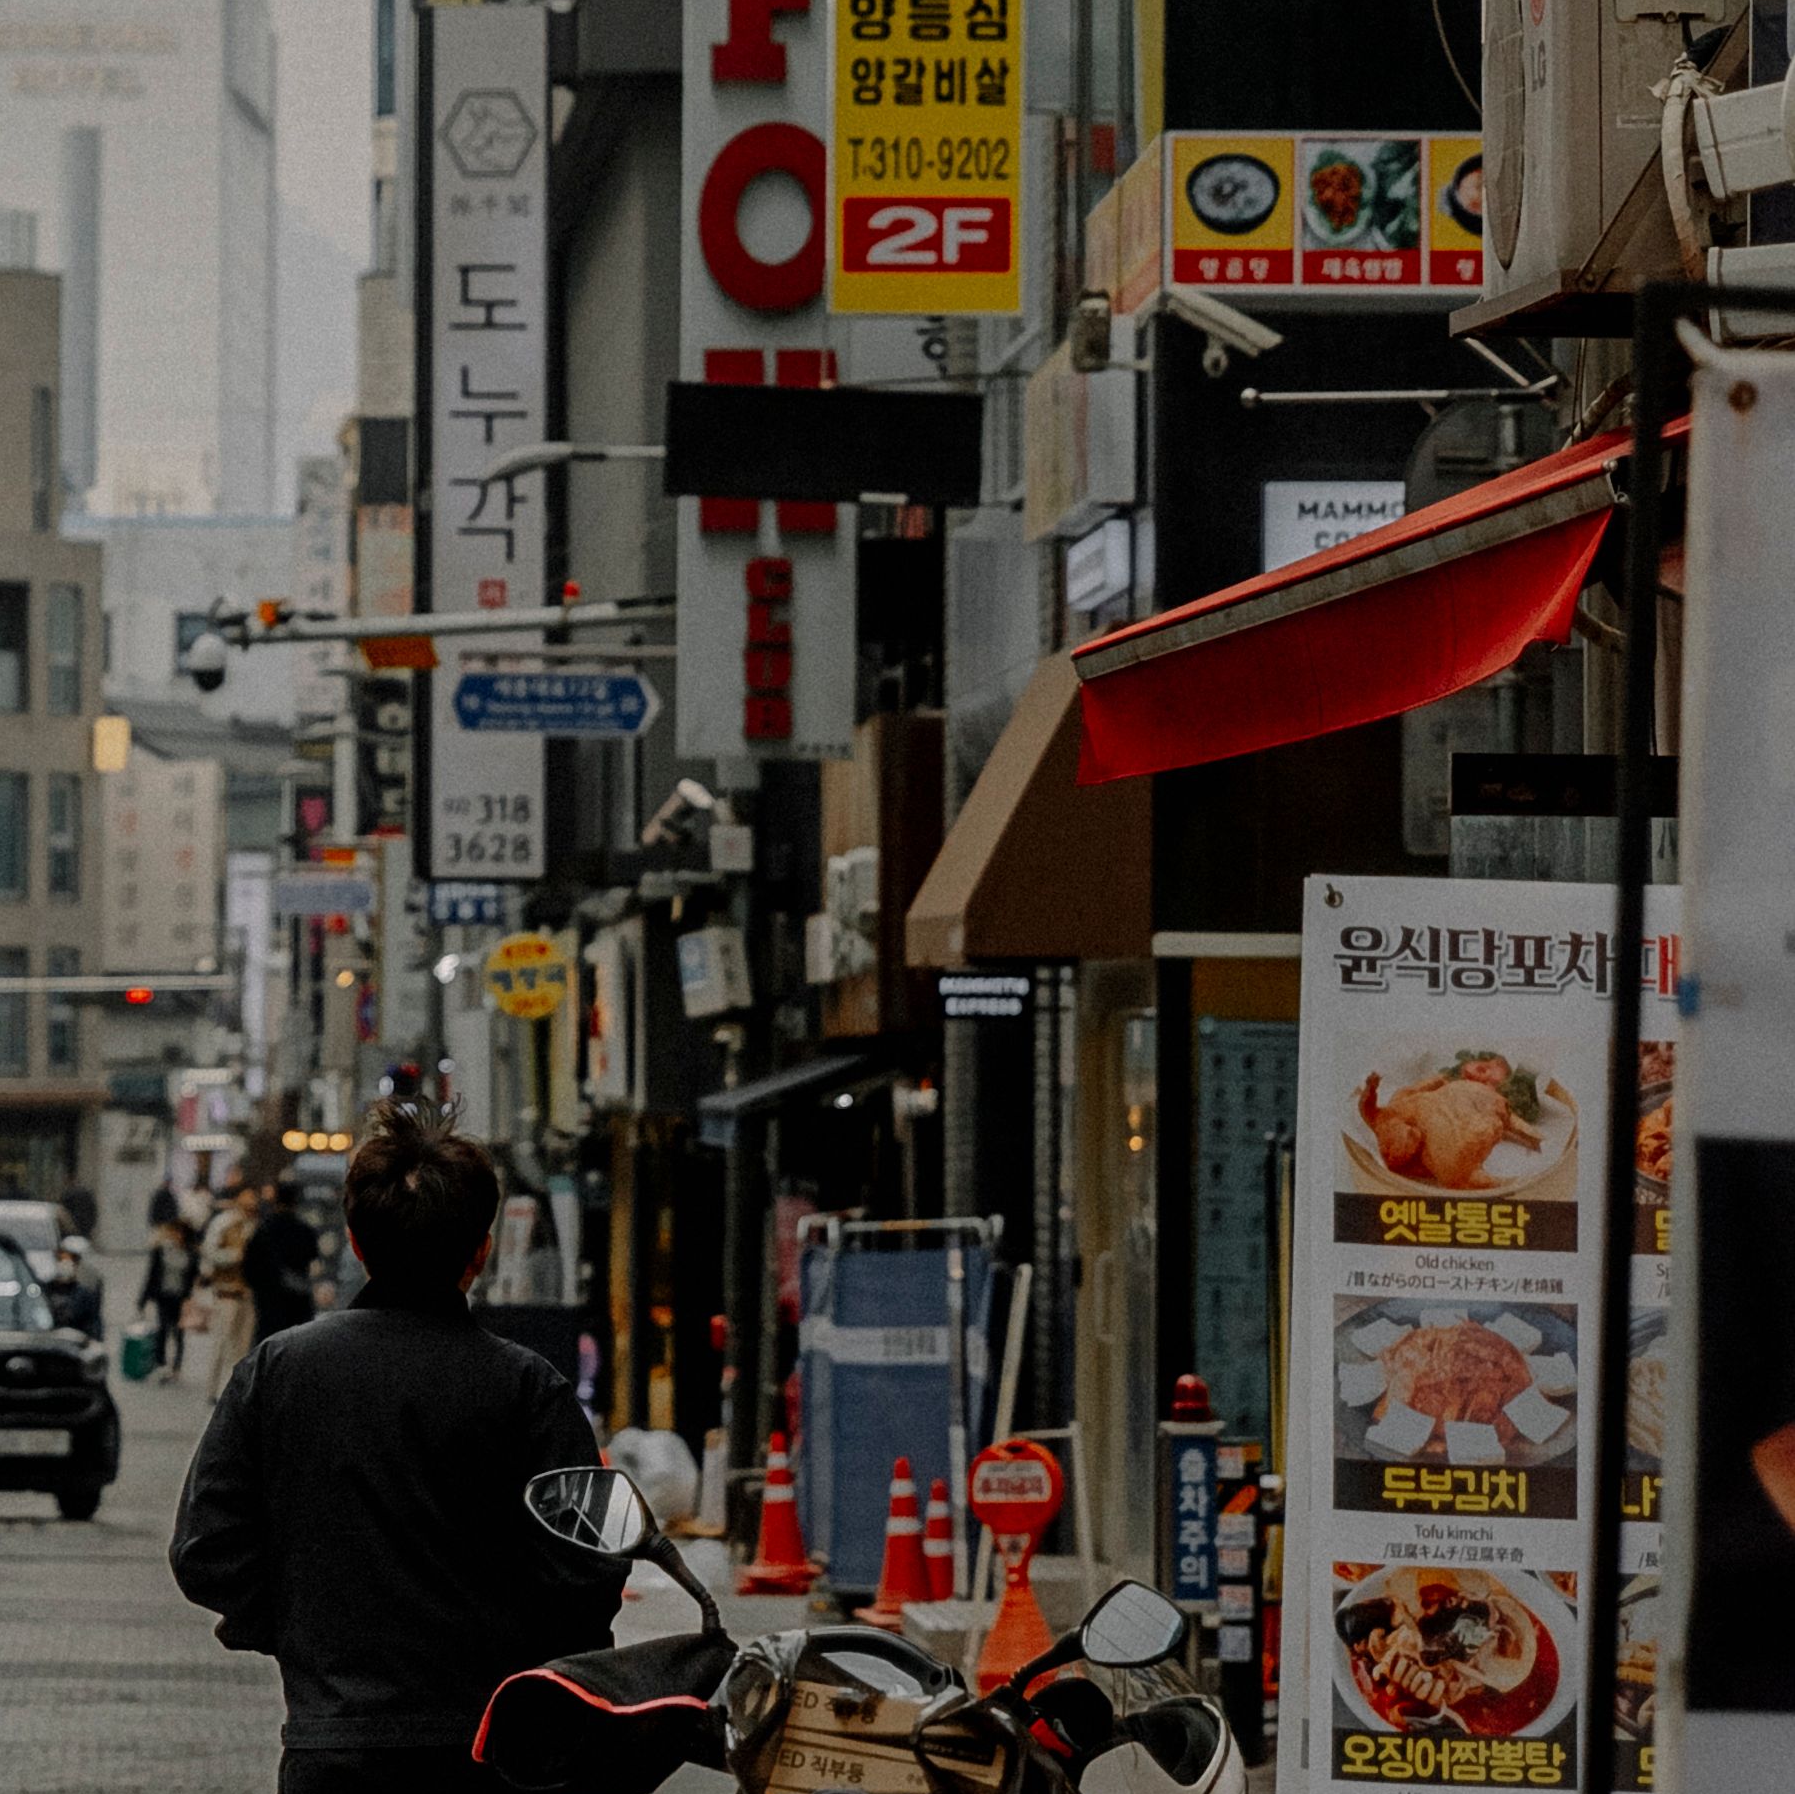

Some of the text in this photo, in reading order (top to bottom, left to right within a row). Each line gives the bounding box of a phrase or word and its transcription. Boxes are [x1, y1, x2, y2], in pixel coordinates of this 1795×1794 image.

[850, 57, 1010, 106] 양갈비살
[1529, 39, 1547, 93] LG
[866, 203, 995, 266] 2F
[447, 263, 529, 565] 도누각
[475, 794, 532, 825] 318
[444, 832, 533, 864] 3628
[1333, 923, 1617, 995] 윤식당포차
[1379, 1199, 1531, 1246] 옛날통닭
[1414, 1254, 1495, 1272] Old chicken
[1381, 1466, 1528, 1514] 두부김치
[1414, 1524, 1494, 1542] Tofu kimchi
[1341, 1734, 1567, 1785] 오징어짬뽕탕
